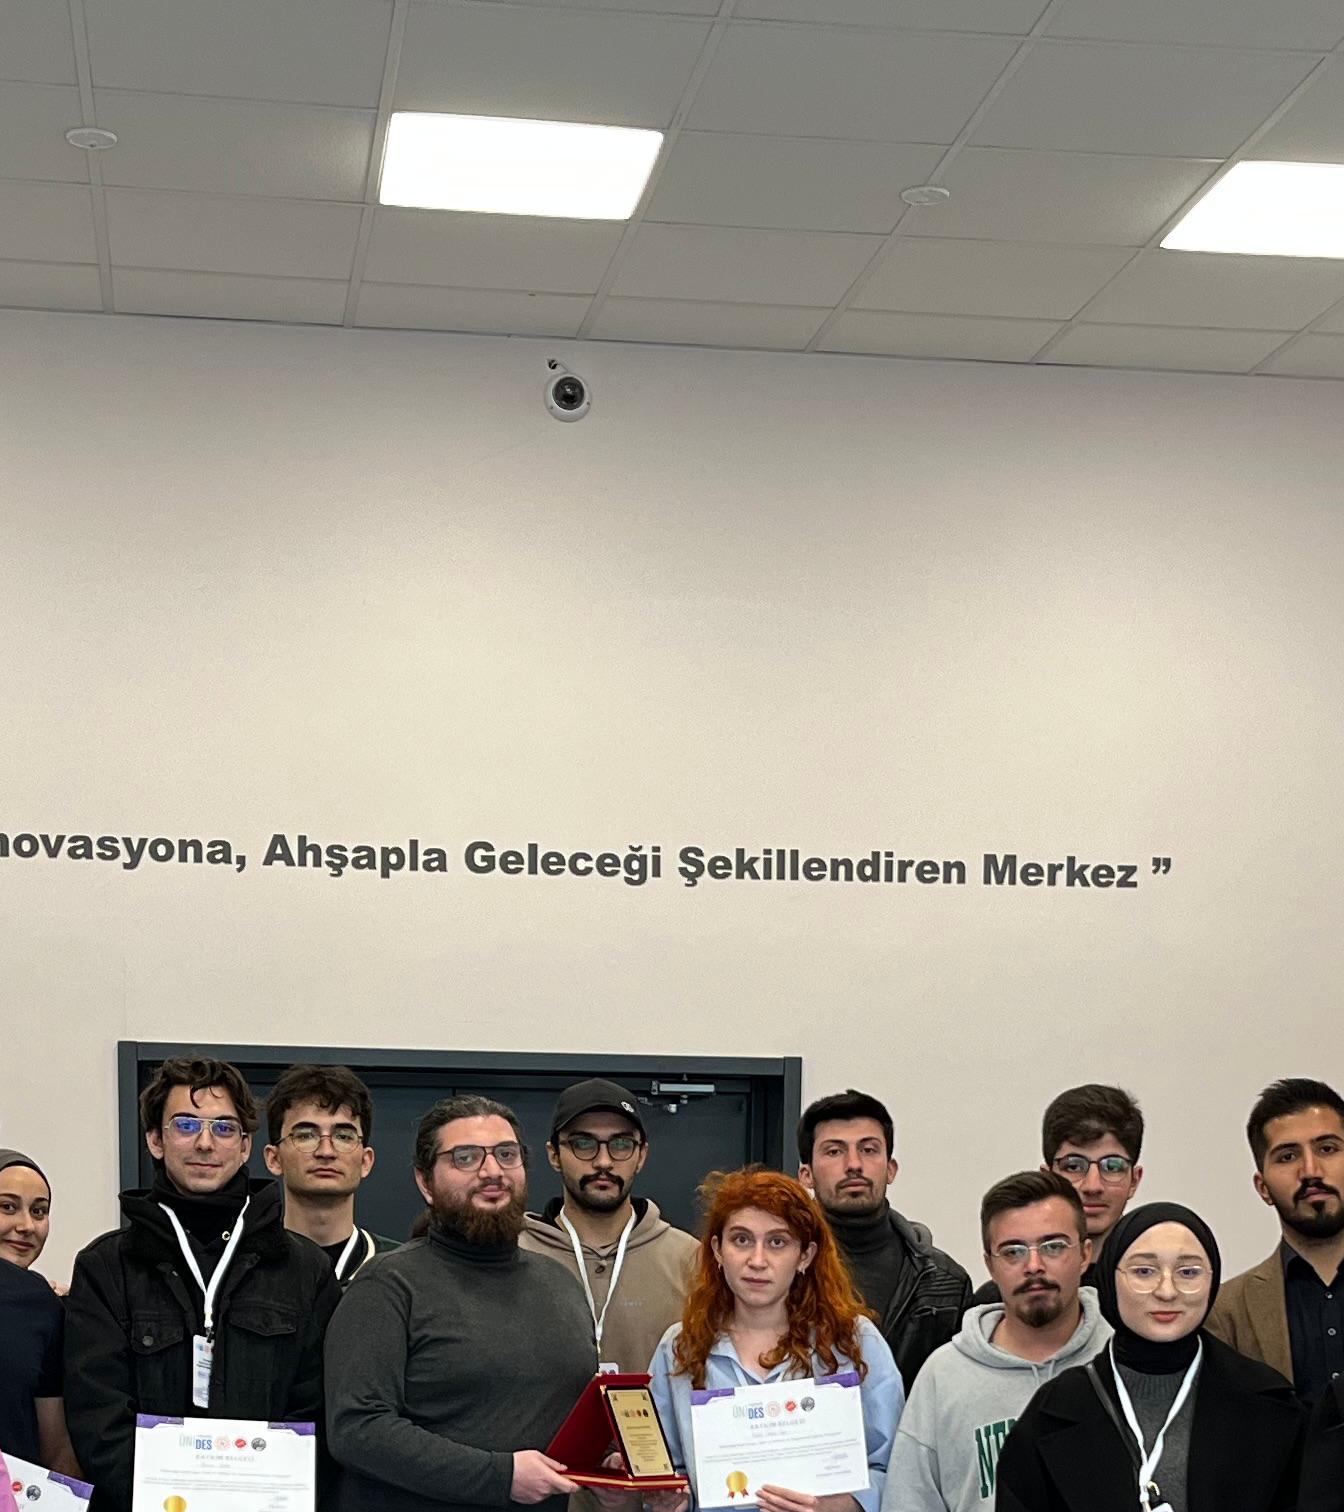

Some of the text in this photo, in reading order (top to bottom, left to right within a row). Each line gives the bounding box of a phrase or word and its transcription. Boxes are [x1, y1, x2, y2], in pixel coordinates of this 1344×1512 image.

[261, 833, 449, 880] Ahşapla
[464, 840, 662, 887] Geleceği
[677, 846, 966, 888] Şekillendiren
[982, 853, 1138, 889] Merkez
